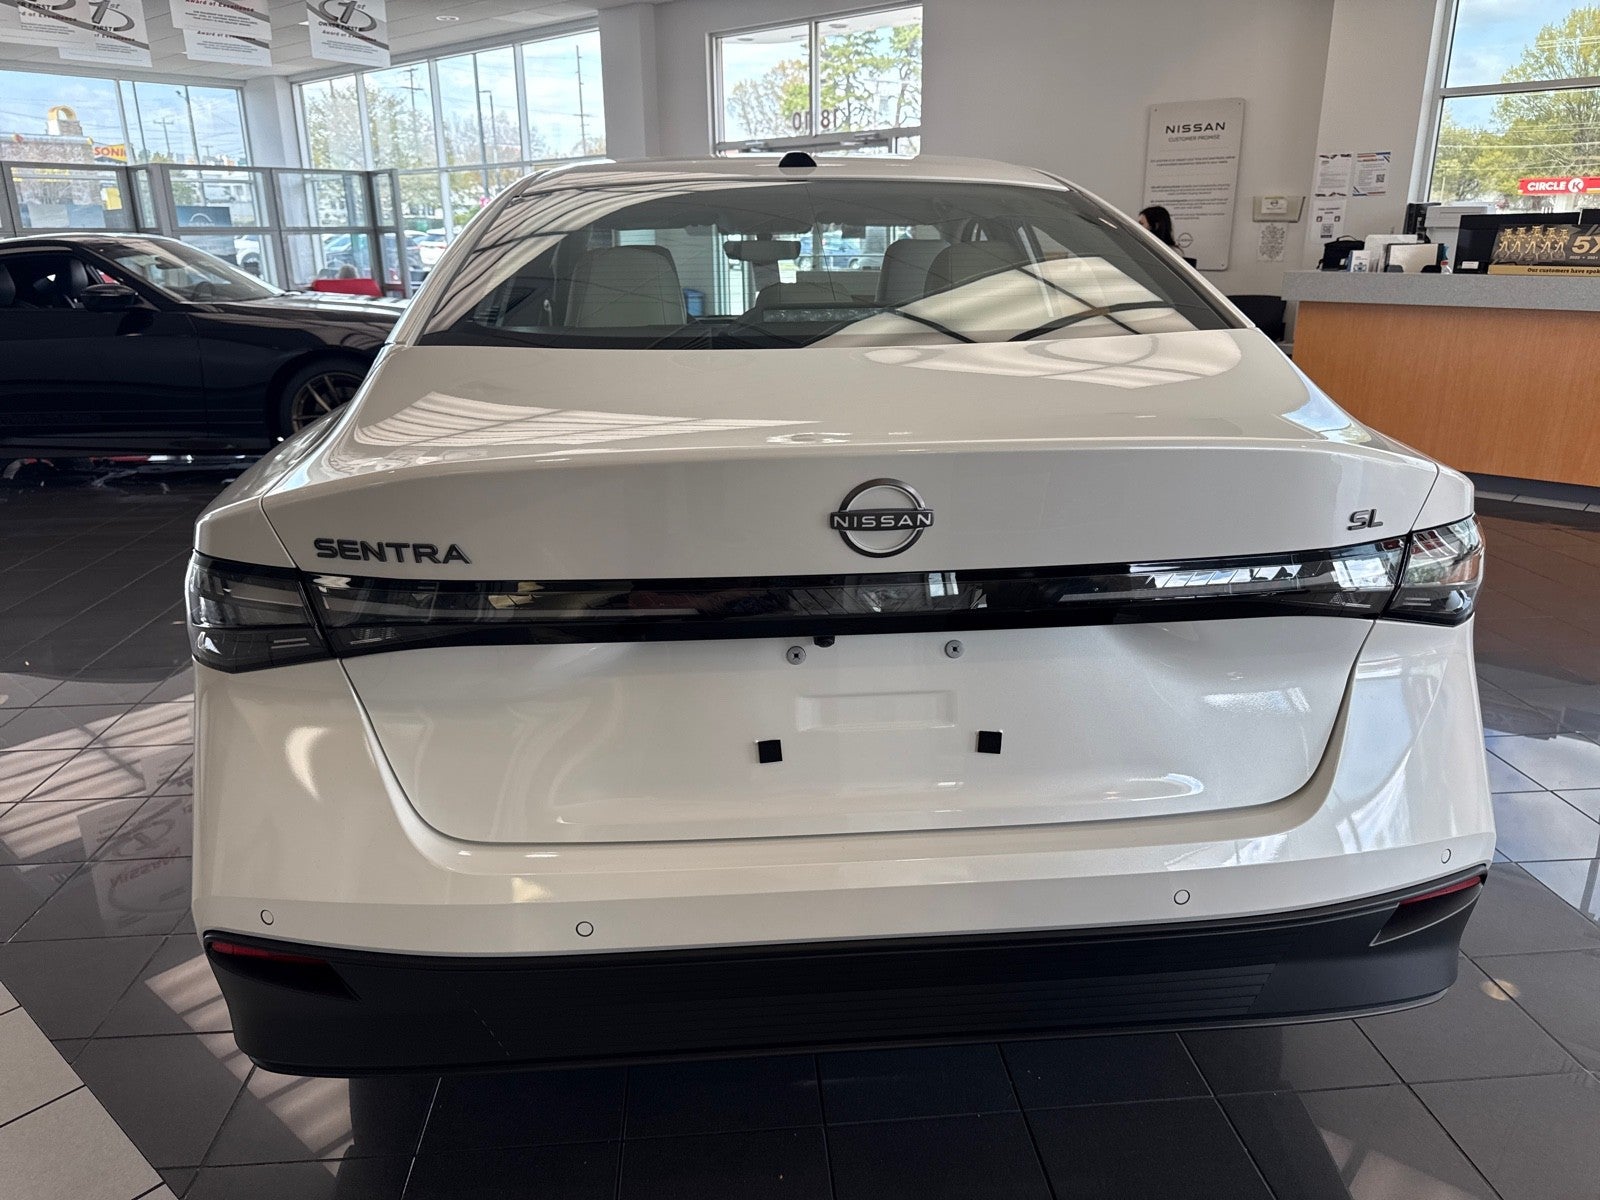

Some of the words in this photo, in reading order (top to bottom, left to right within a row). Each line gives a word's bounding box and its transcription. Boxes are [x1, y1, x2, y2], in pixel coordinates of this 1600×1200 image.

[1165, 122, 1226, 134] NISSAN
[95, 147, 126, 157] SONI
[1526, 181, 1566, 192] CIRCLE
[1569, 179, 1583, 192] K
[833, 513, 932, 528] NISSAN
[1347, 508, 1384, 531] SL
[313, 537, 473, 565] SENTRA
